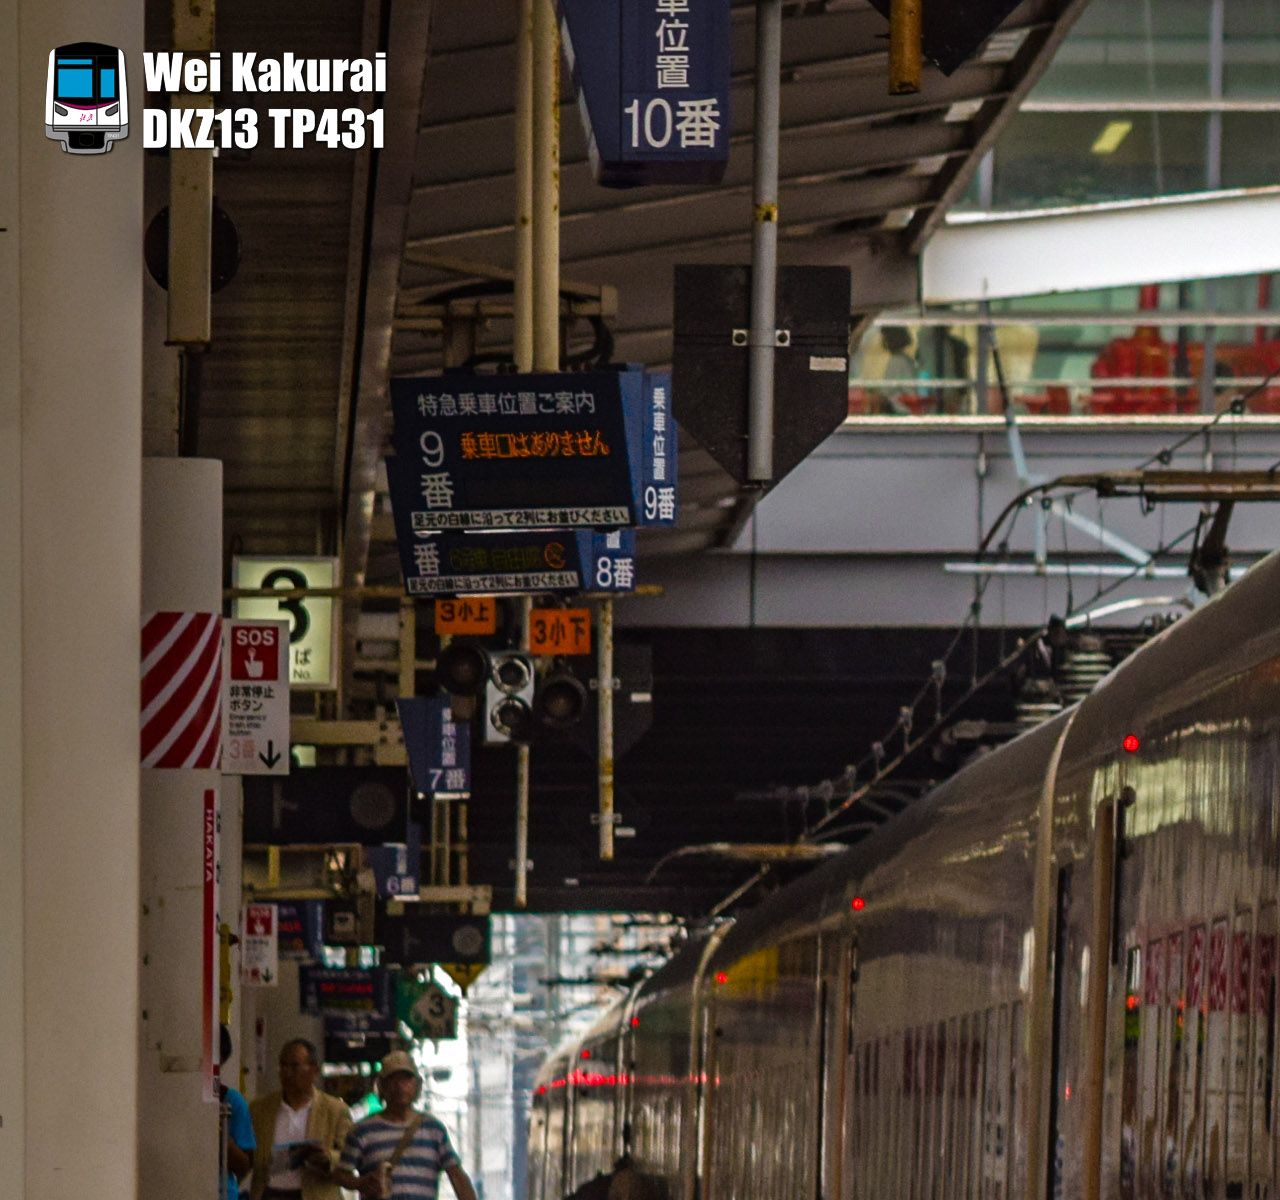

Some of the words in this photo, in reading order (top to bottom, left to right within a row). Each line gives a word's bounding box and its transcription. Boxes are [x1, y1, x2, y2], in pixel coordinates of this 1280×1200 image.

[624, 98, 720, 148] 10番
[417, 391, 596, 416] 特急乗車位置ご案内
[644, 486, 675, 520] 9番
[596, 557, 634, 588] 8番
[440, 603, 490, 623] 3小上
[236, 629, 274, 646] SOS
[534, 617, 586, 646] 3小下
[230, 685, 275, 698] 非常停止
[230, 699, 263, 711] ボタン
